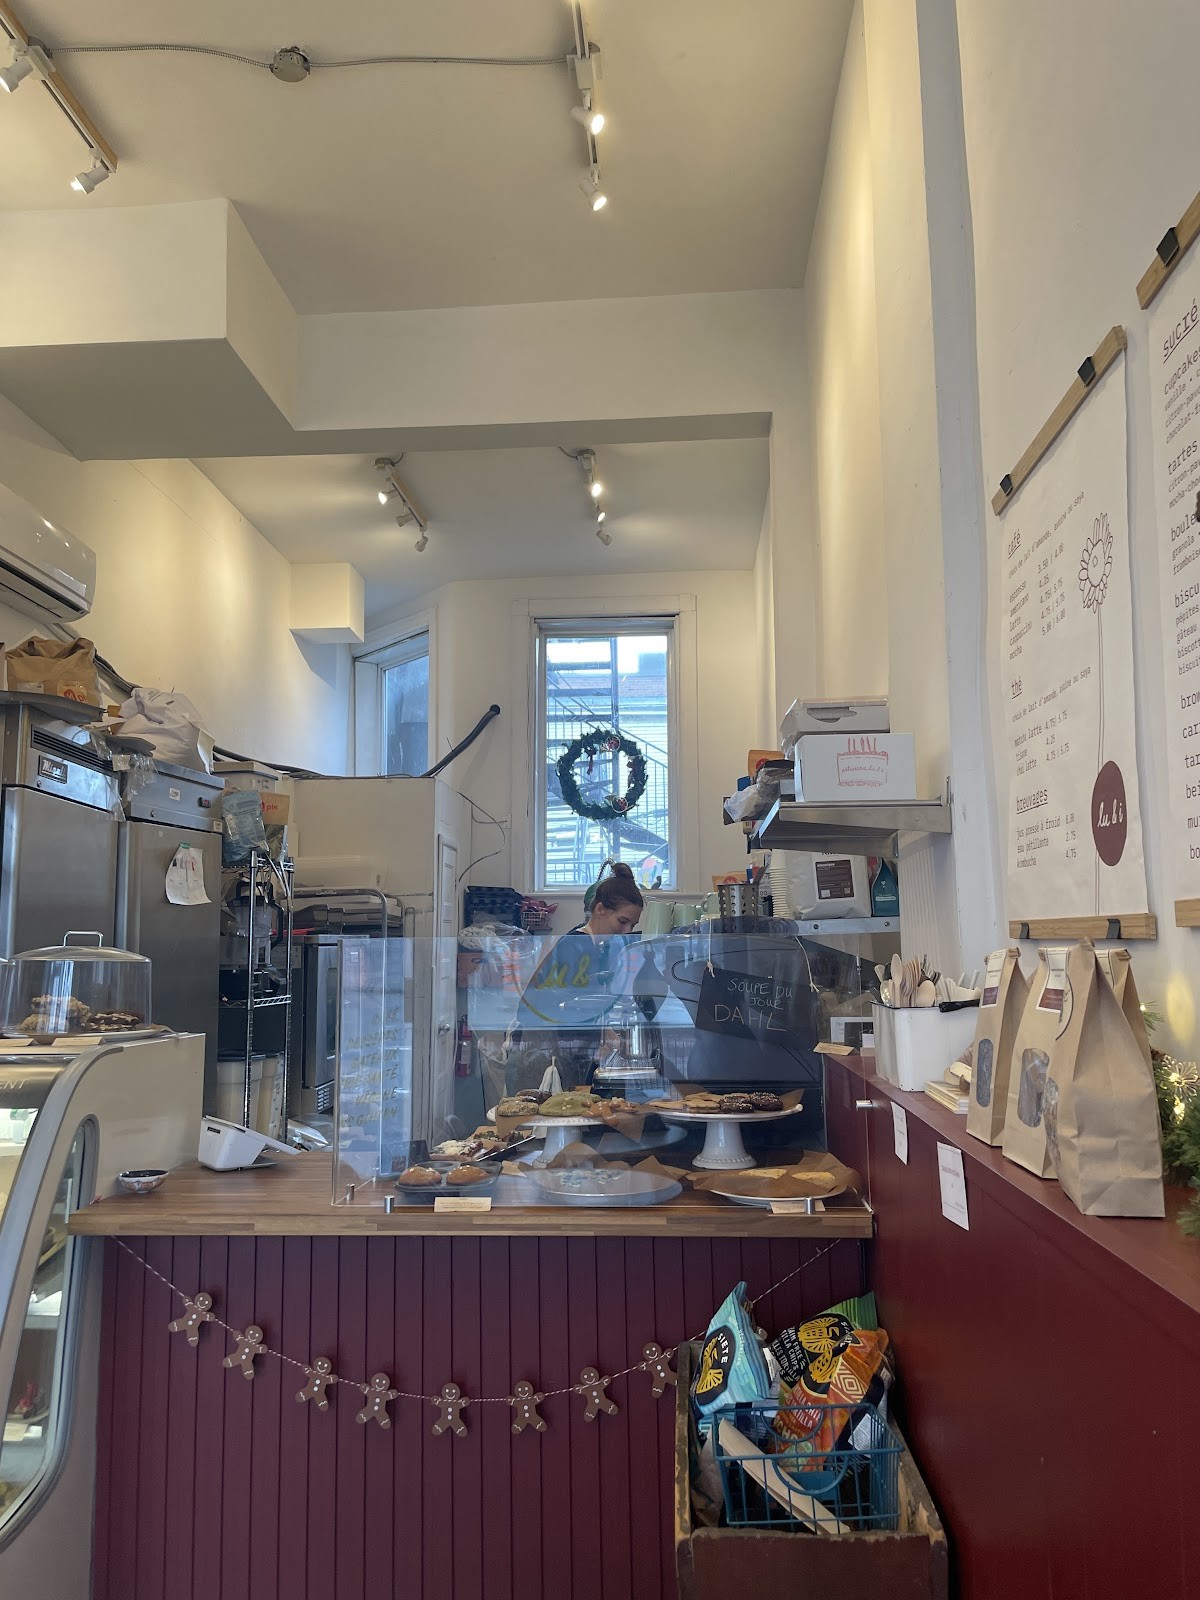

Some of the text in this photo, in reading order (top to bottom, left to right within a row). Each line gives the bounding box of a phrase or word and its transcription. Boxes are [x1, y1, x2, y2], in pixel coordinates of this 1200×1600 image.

[1163, 297, 1198, 358] sucré
[1164, 346, 1200, 395] cupcake
[1168, 440, 1198, 475] tartes
[1007, 528, 1021, 556] café
[1080, 666, 1091, 679] soya
[1011, 675, 1023, 696] thé
[1028, 725, 1042, 739] latte
[1016, 789, 1048, 812] breuvages
[1045, 815, 1061, 830] froid
[1065, 848, 1077, 859] 4.75
[727, 978, 793, 999] SOUPE DU
[714, 1004, 787, 1032] DAHL
[717, 1332, 730, 1364] SIETE
[792, 1341, 804, 1360] FREE
[788, 1349, 799, 1371] CHIPS
